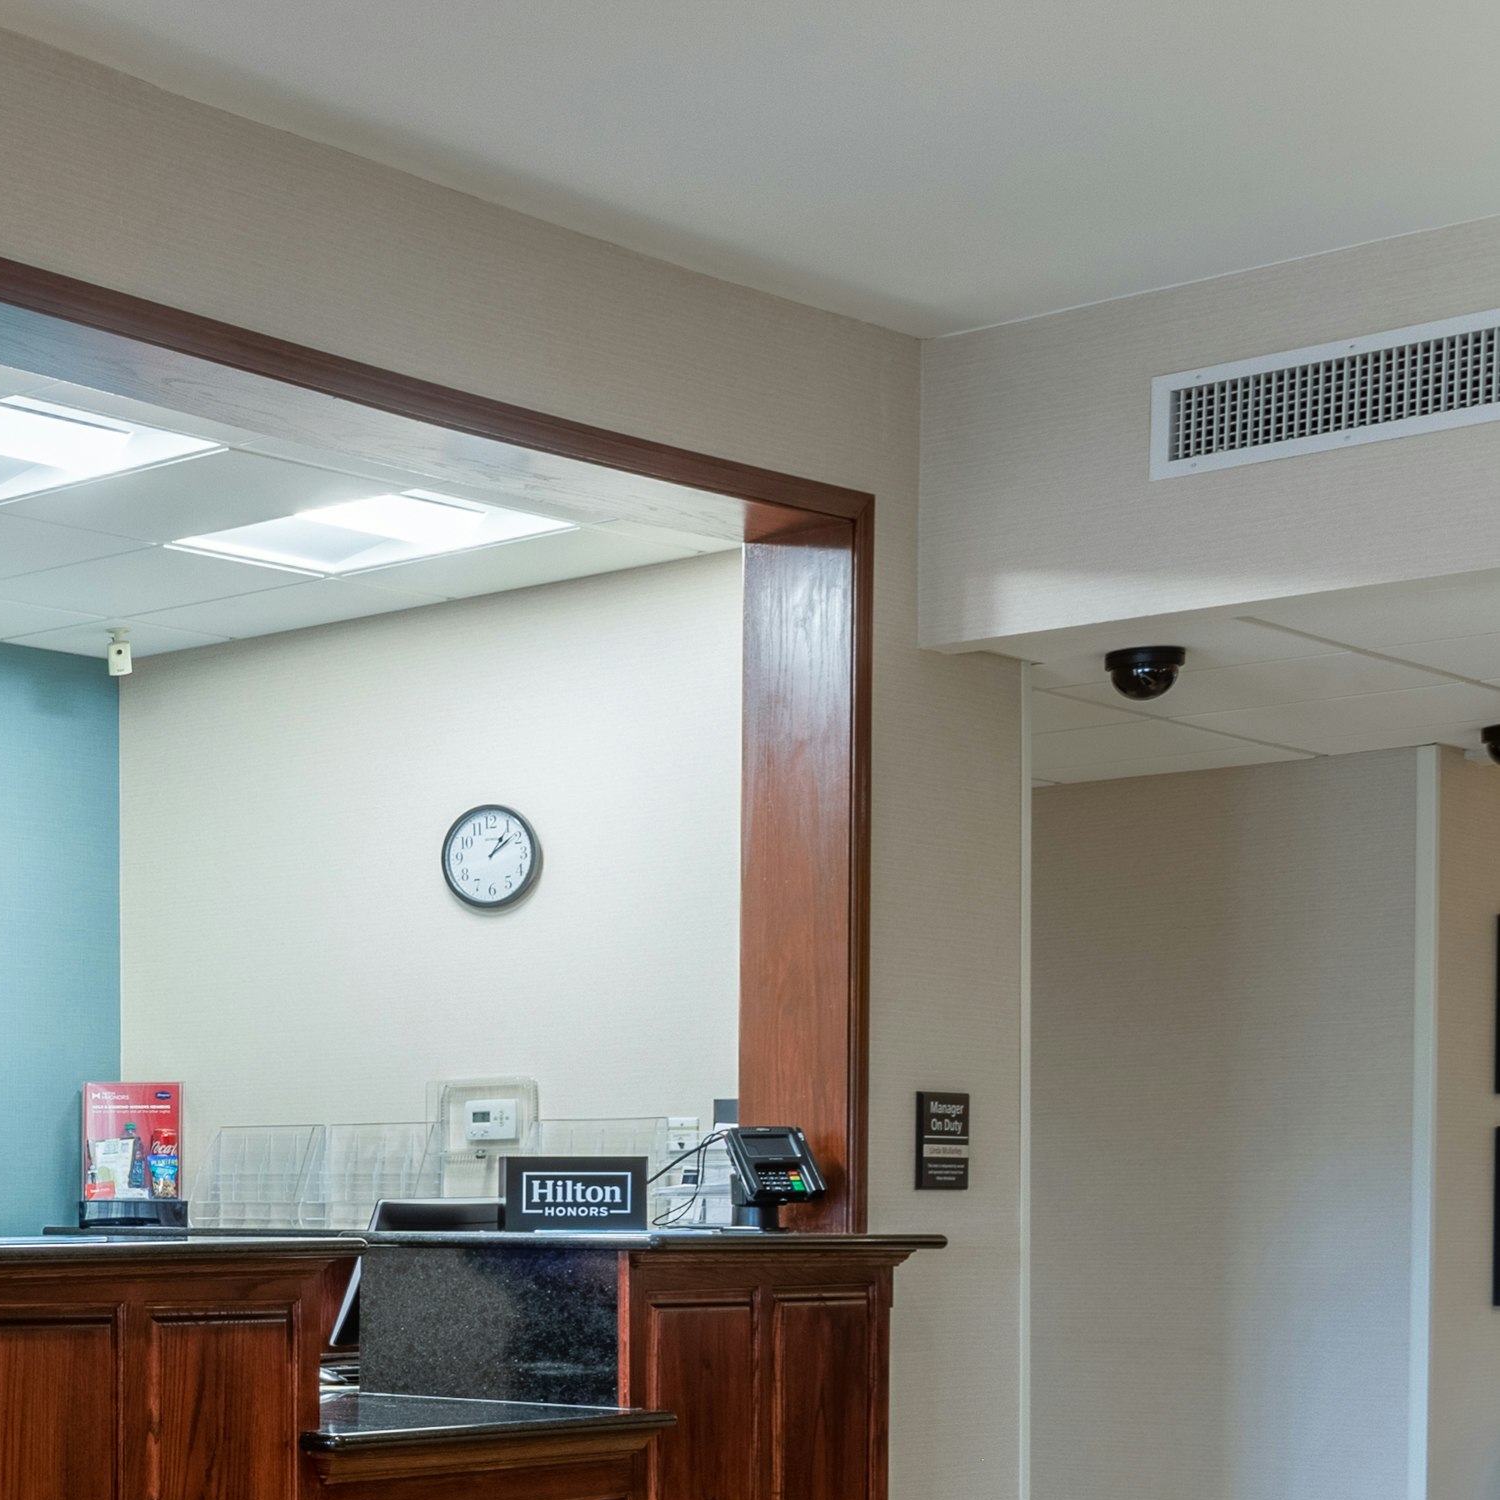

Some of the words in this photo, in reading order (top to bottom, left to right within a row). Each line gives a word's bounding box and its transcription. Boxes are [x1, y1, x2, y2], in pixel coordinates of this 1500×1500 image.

[472, 822, 482, 836] 11
[485, 815, 497, 829] 12
[505, 819, 510, 832] 1
[460, 836, 473, 849] 10
[514, 831, 522, 844] 2
[456, 852, 464, 865] 9
[520, 846, 528, 860] 3
[461, 868, 469, 881] 8
[516, 863, 523, 876] 4
[473, 878, 481, 892] 7
[488, 882, 497, 896] 6
[504, 875, 512, 889] 5
[929, 1101, 965, 1117] Manager
[930, 1118, 943, 1131] On
[944, 1118, 963, 1134] Duty
[531, 1180, 622, 1203] Hilton
[544, 1206, 609, 1217] HONORS
